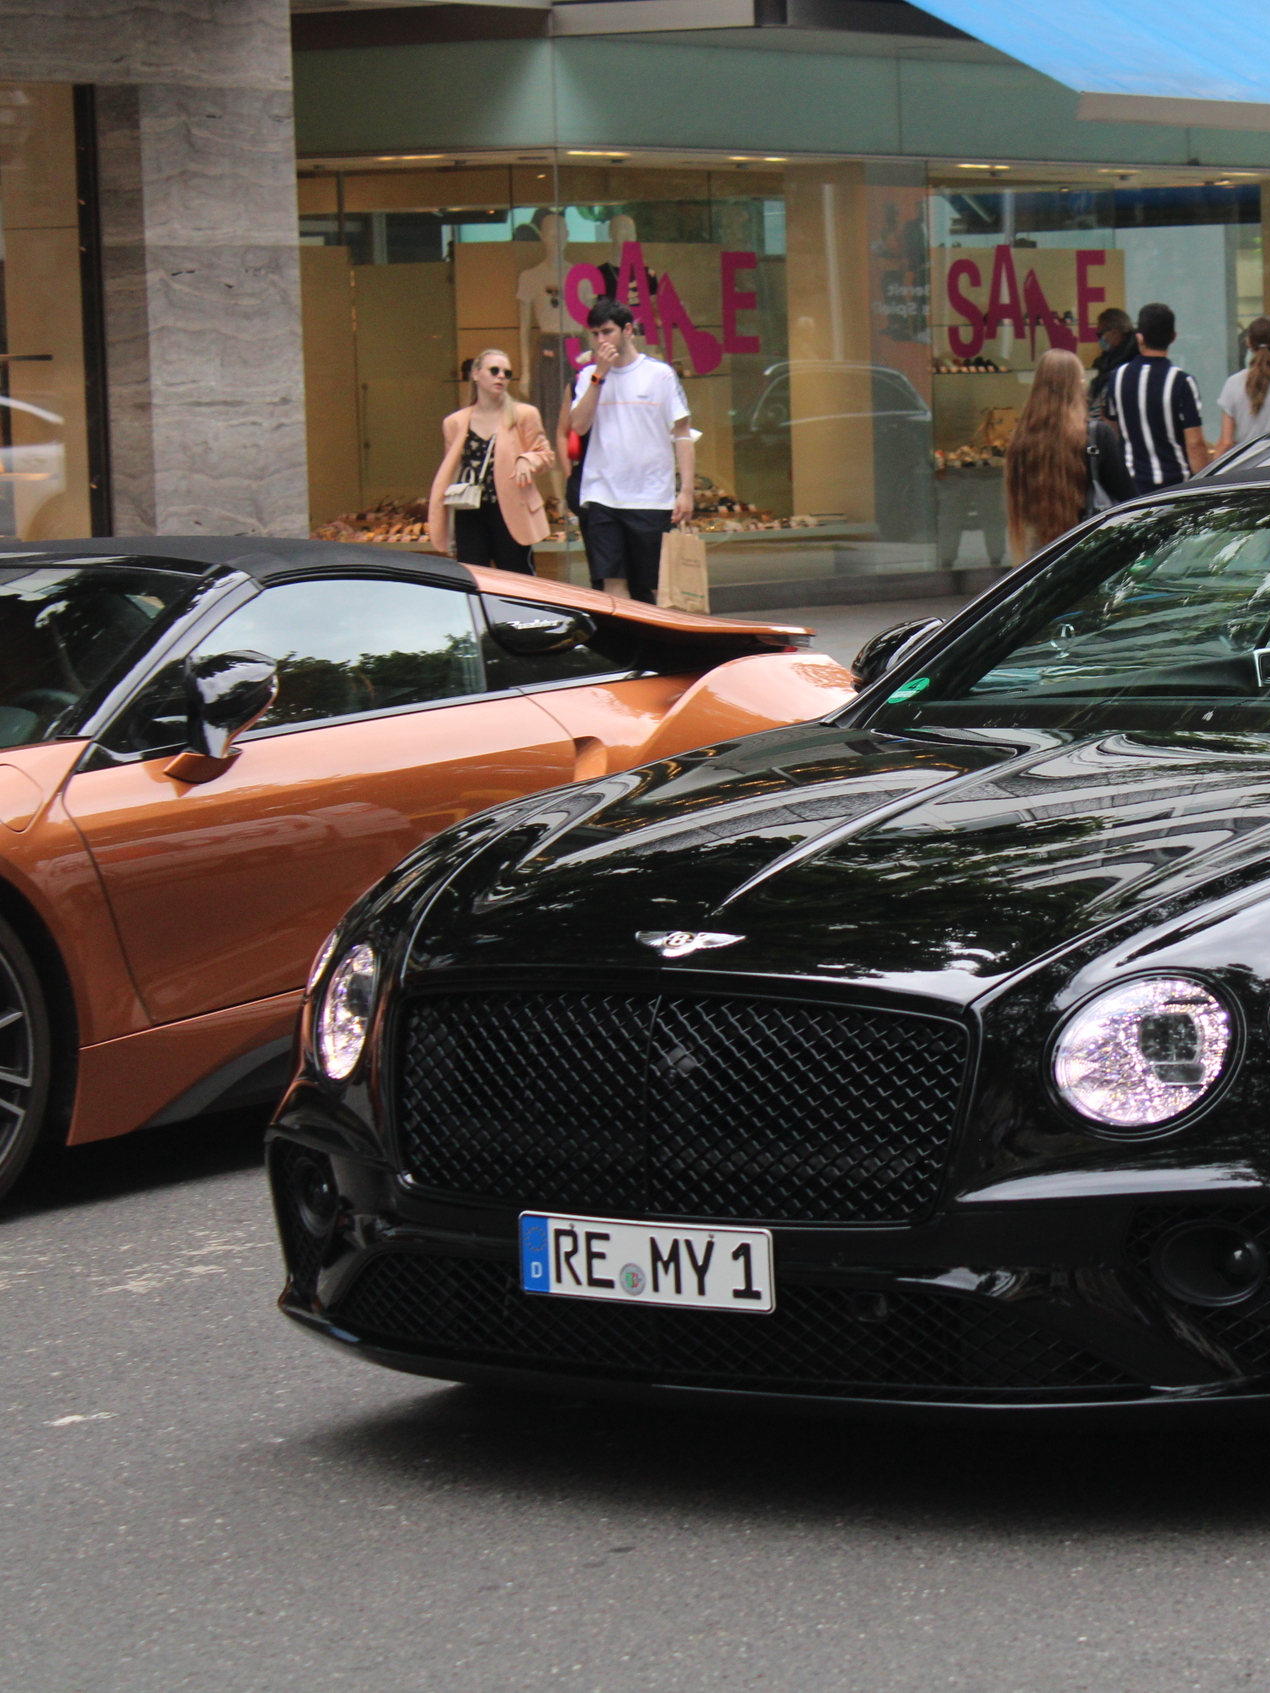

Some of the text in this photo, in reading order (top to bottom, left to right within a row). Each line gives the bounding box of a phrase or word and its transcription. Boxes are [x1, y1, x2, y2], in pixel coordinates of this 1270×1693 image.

[947, 244, 1107, 361] SALE
[531, 1262, 543, 1279] D
[554, 1228, 762, 1300] RE MY 1
